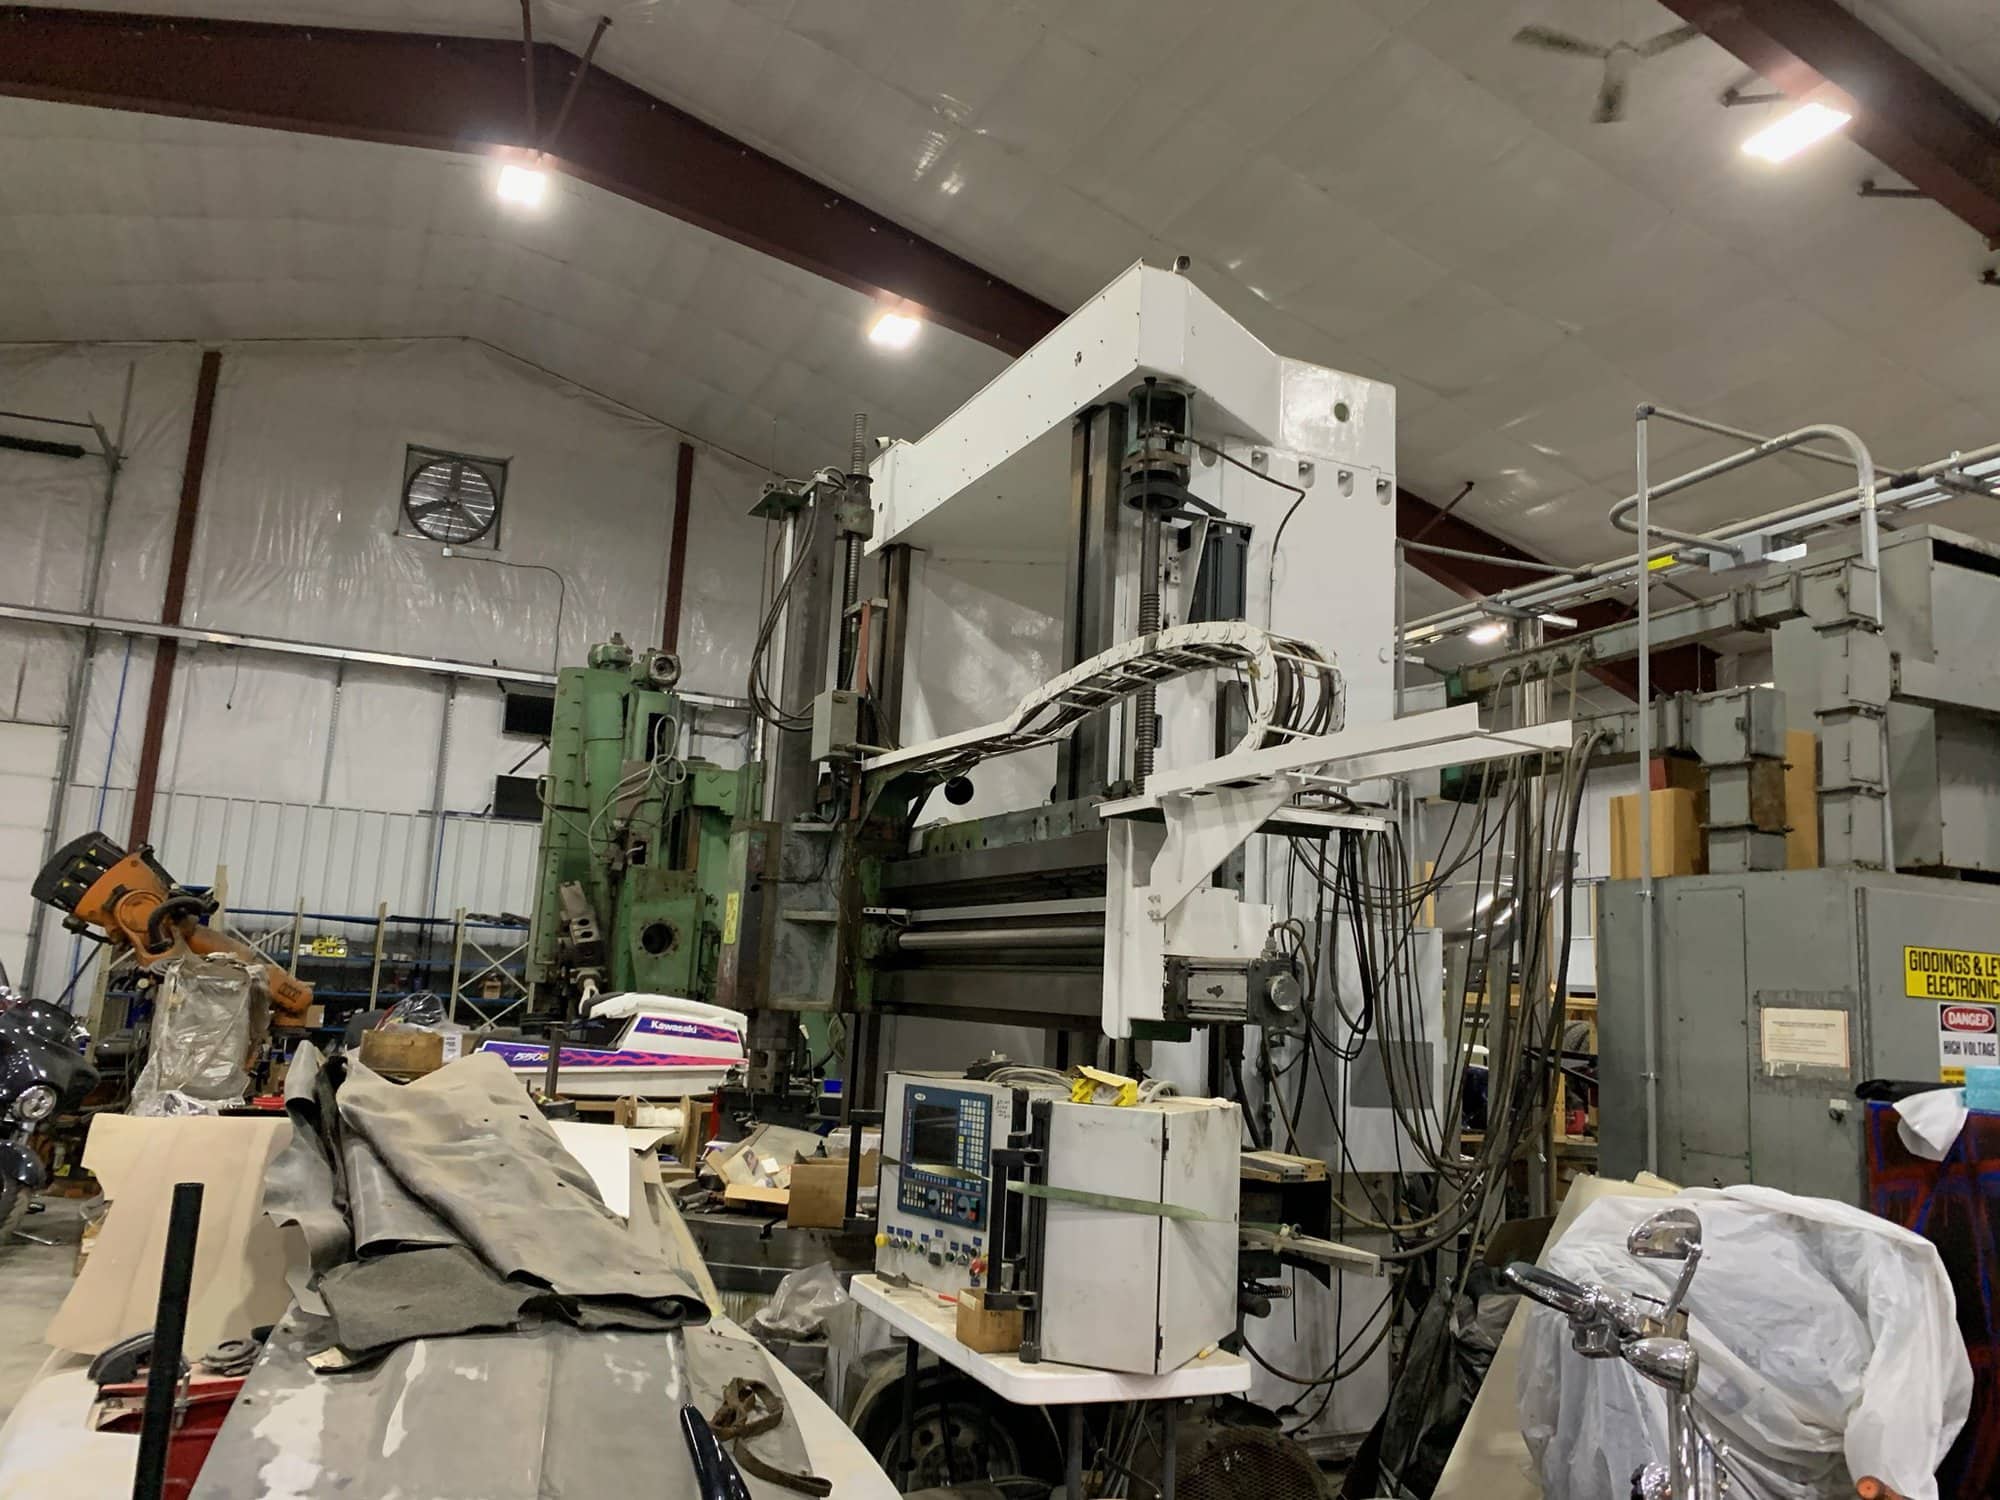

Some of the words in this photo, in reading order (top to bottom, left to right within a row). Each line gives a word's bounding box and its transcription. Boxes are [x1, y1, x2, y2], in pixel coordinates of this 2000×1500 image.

[1909, 950, 1970, 975] GIDDINGS
[1973, 955, 1983, 976] &
[1985, 956, 2000, 977] LE
[1948, 1011, 1989, 1027] DANGER
[651, 1020, 697, 1034] Kawasaki
[1944, 1041, 1961, 1055] HIGH
[1963, 1041, 1996, 1056] VOLTAGE
